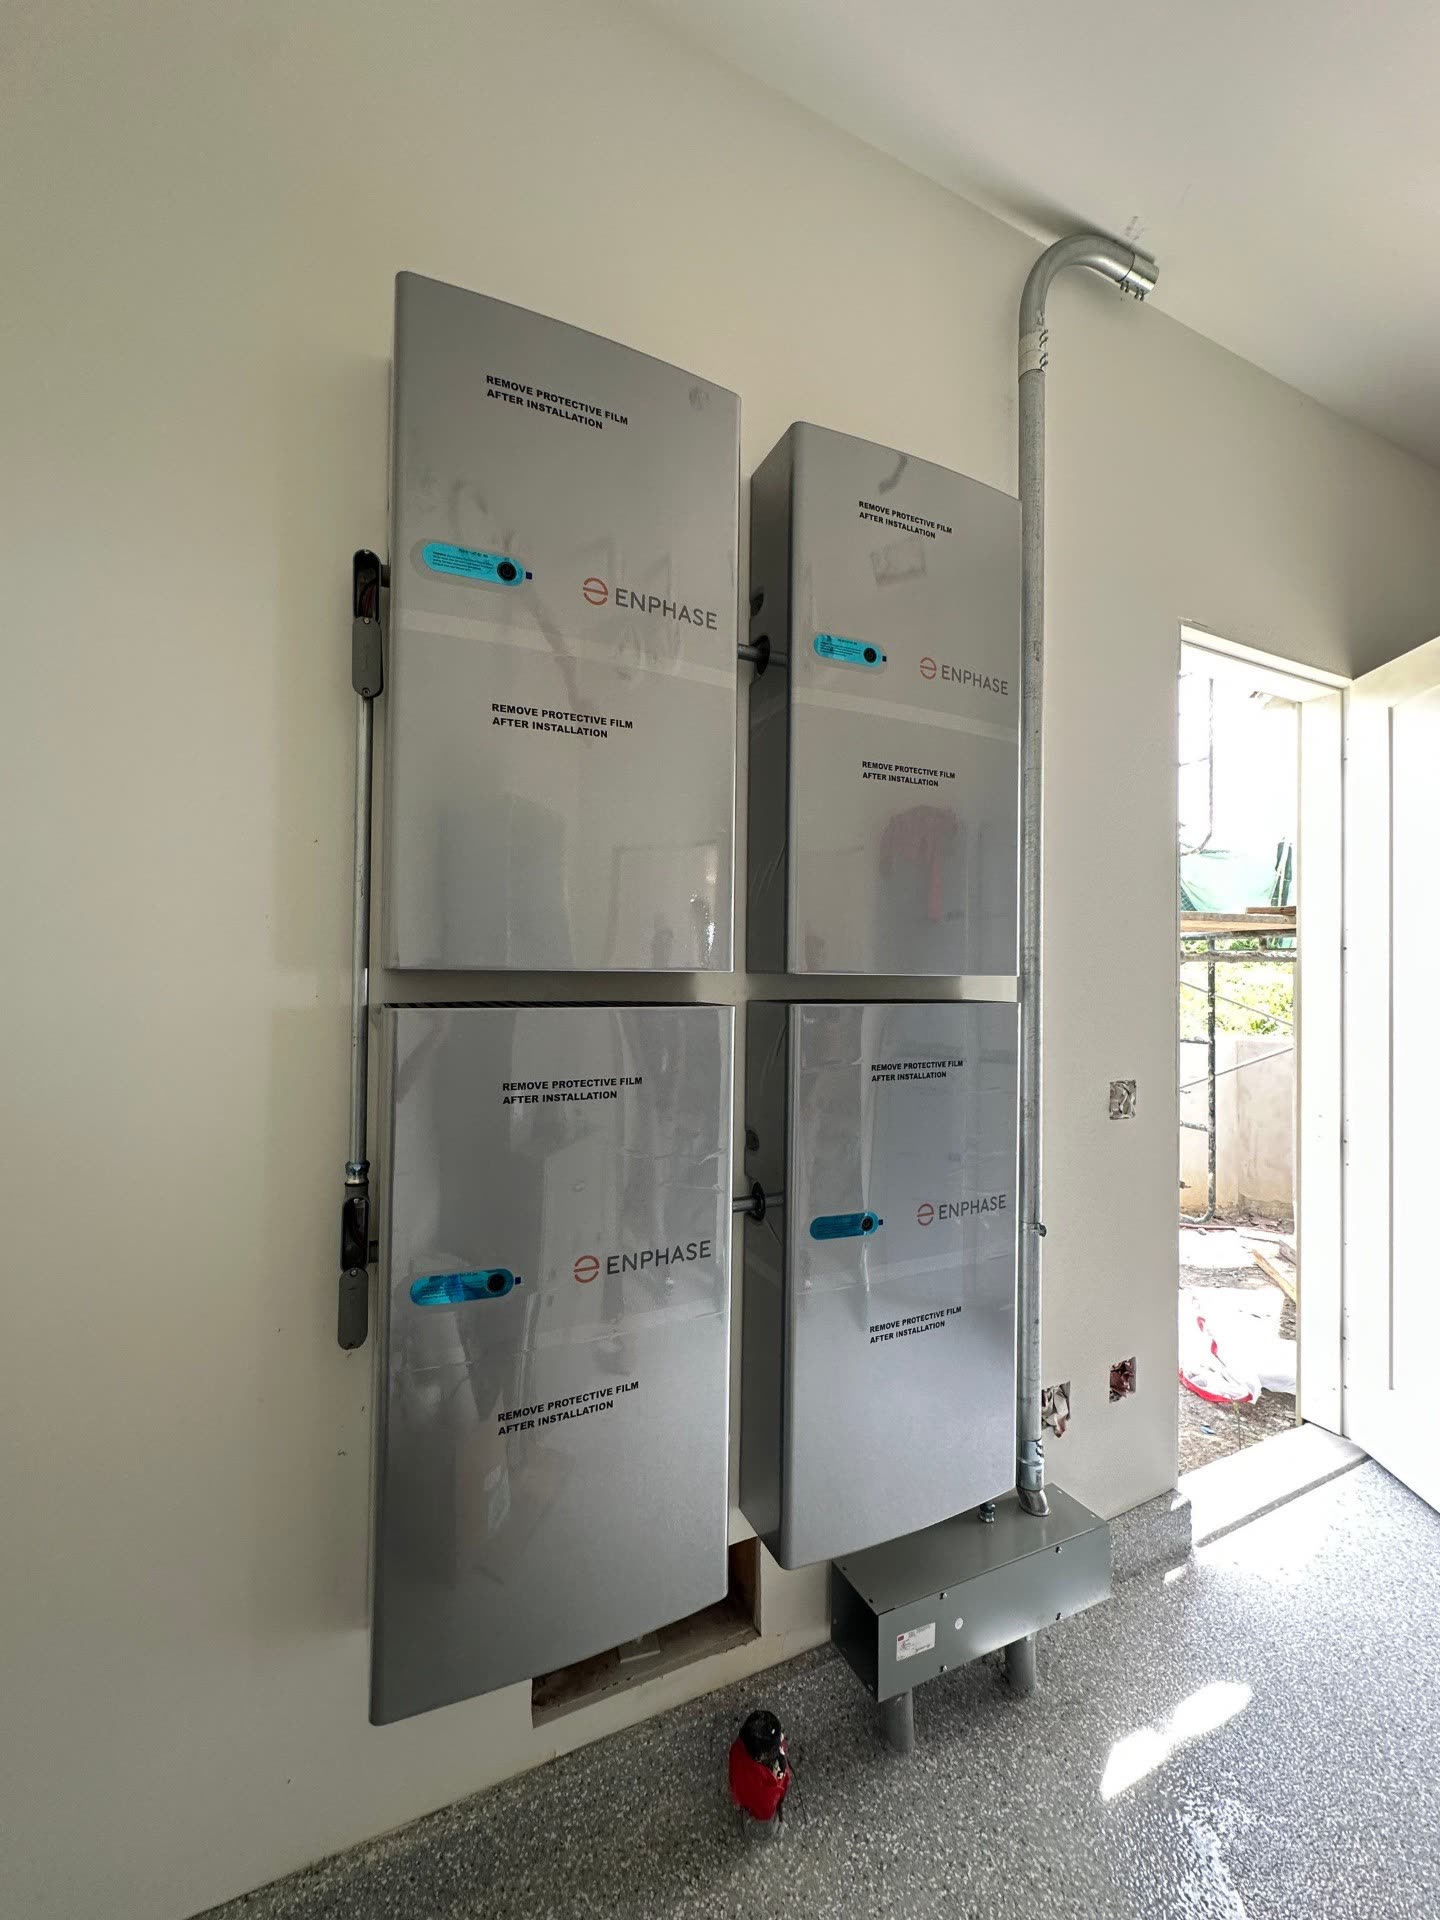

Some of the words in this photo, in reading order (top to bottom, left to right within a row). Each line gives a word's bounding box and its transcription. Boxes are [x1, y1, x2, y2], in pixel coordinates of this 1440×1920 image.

[487, 375, 533, 397] REMOVE
[537, 390, 602, 416] PROTECTIVE
[605, 411, 627, 425] FILM
[487, 389, 523, 406] AFTER
[527, 400, 602, 429] INSTALLATION
[859, 501, 890, 517] REMOVE
[892, 510, 935, 528] PROTECTIVE
[937, 524, 952, 533] FILM
[859, 512, 883, 524] AFTER
[886, 519, 935, 538] INSTALLATION
[616, 588, 717, 630] ENPHASE
[942, 665, 1008, 695] ENPHASE
[492, 704, 538, 716] REMOVE
[542, 710, 607, 725] PROTECTIVE
[610, 719, 632, 728] FILM
[492, 717, 528, 728] AFTER
[533, 722, 607, 738] INSTALLATION
[862, 761, 893, 771] REMOVE
[895, 765, 938, 776] PROTECTIVE
[863, 772, 886, 780] AFTER
[889, 775, 938, 786] INSTALLATION
[871, 1063, 901, 1071] REMOVE
[904, 1061, 946, 1069] PROTECTIVE
[872, 1074, 895, 1082] AFTER
[897, 1071, 946, 1080] INSTALLATION
[503, 1081, 548, 1091] REMOVE
[552, 1078, 617, 1088] PROTECTIVE
[620, 1077, 642, 1085] FILM
[503, 1095, 539, 1104] AFTER
[543, 1091, 617, 1102] INSTALLATION
[940, 1194, 1007, 1220] ENPHASE
[607, 1240, 711, 1275] ENPHASE
[870, 1321, 900, 1333] REMOVE
[902, 1310, 944, 1326] PROTECTIVE
[947, 1306, 961, 1315] FILM
[870, 1333, 893, 1343] AFTER
[896, 1321, 945, 1337] INSTALLATION
[498, 1404, 544, 1422] REMOVE
[548, 1388, 613, 1410] PROTECTIVE
[616, 1381, 638, 1393] FILM
[498, 1420, 534, 1435] AFTER
[538, 1400, 613, 1426] INSTALLATION
